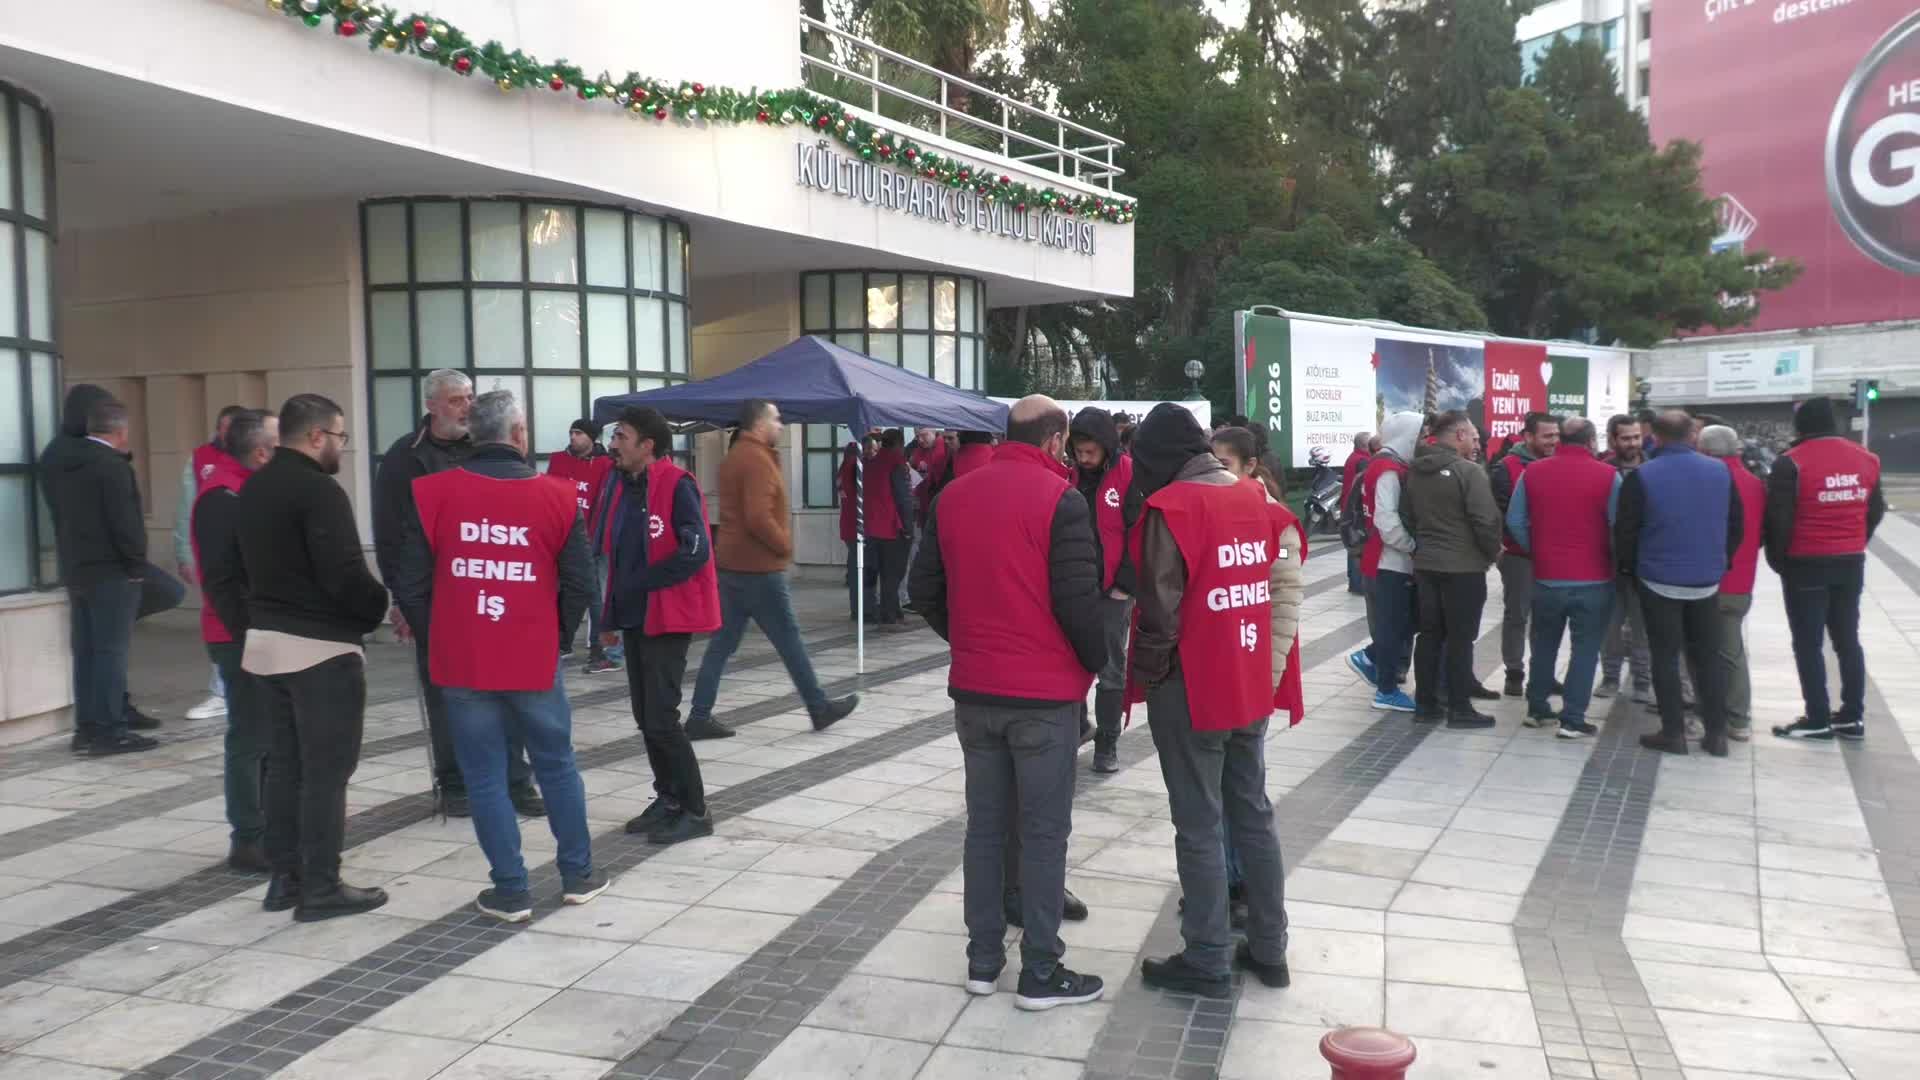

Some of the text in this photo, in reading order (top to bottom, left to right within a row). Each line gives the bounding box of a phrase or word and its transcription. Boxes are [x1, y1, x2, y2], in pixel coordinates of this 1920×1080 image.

[956, 190, 968, 225] 9
[1491, 368, 1521, 391] İZMİR
[1268, 362, 1282, 432] 2026
[1491, 394, 1515, 415] YENİ
[1825, 473, 1860, 489] DİSK
[460, 518, 529, 547] DİSK
[1217, 538, 1268, 569] DİSK
[451, 557, 537, 582] GENEL
[477, 590, 506, 622] İŞ
[1207, 580, 1271, 611] GENEL
[1239, 619, 1258, 652] İŞ
